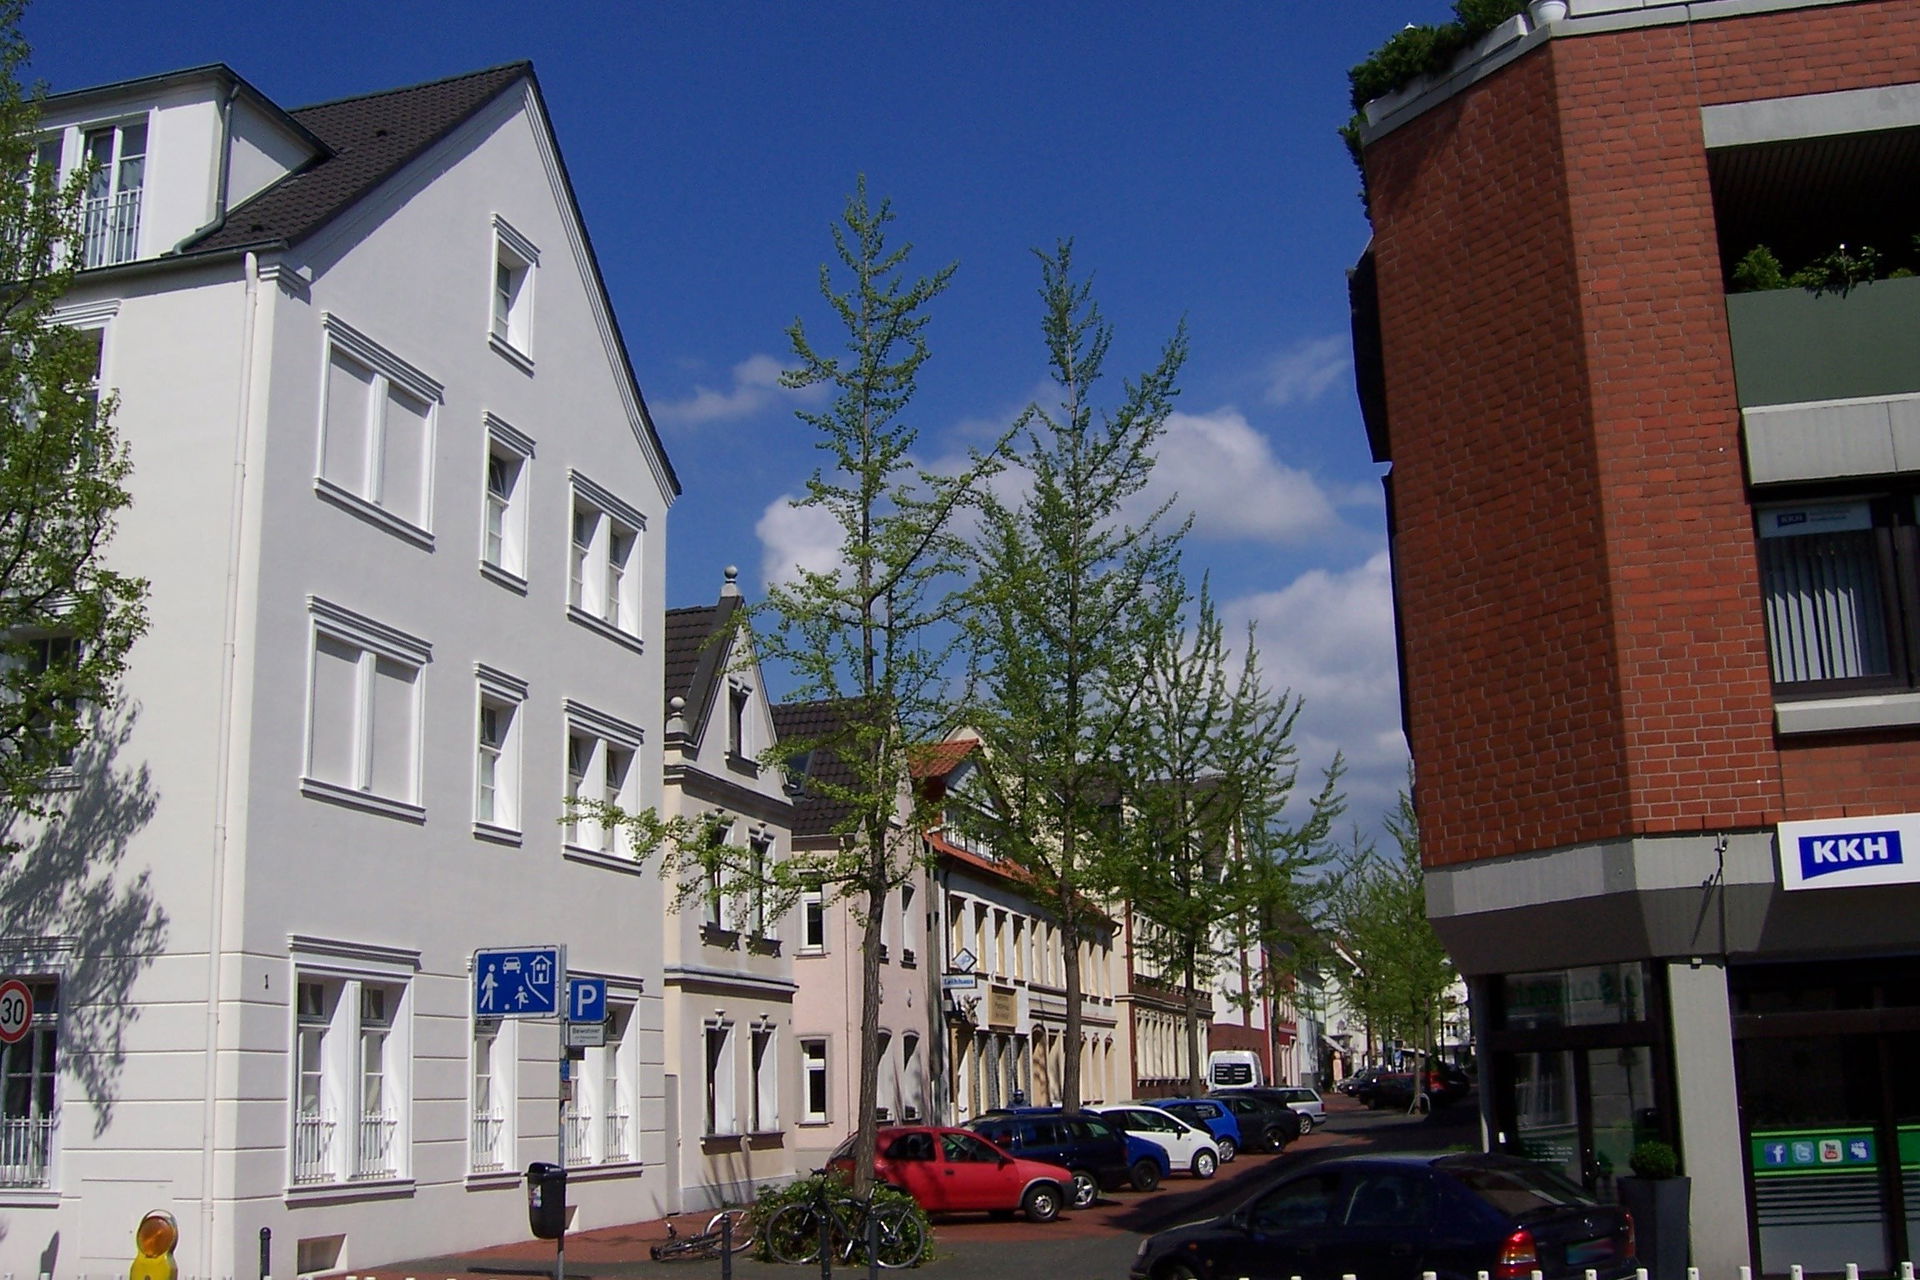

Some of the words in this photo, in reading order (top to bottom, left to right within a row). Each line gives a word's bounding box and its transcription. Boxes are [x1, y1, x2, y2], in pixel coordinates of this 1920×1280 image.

[1812, 836, 1889, 864] KKH
[1, 997, 25, 1025] 30
[577, 984, 598, 1017] P
